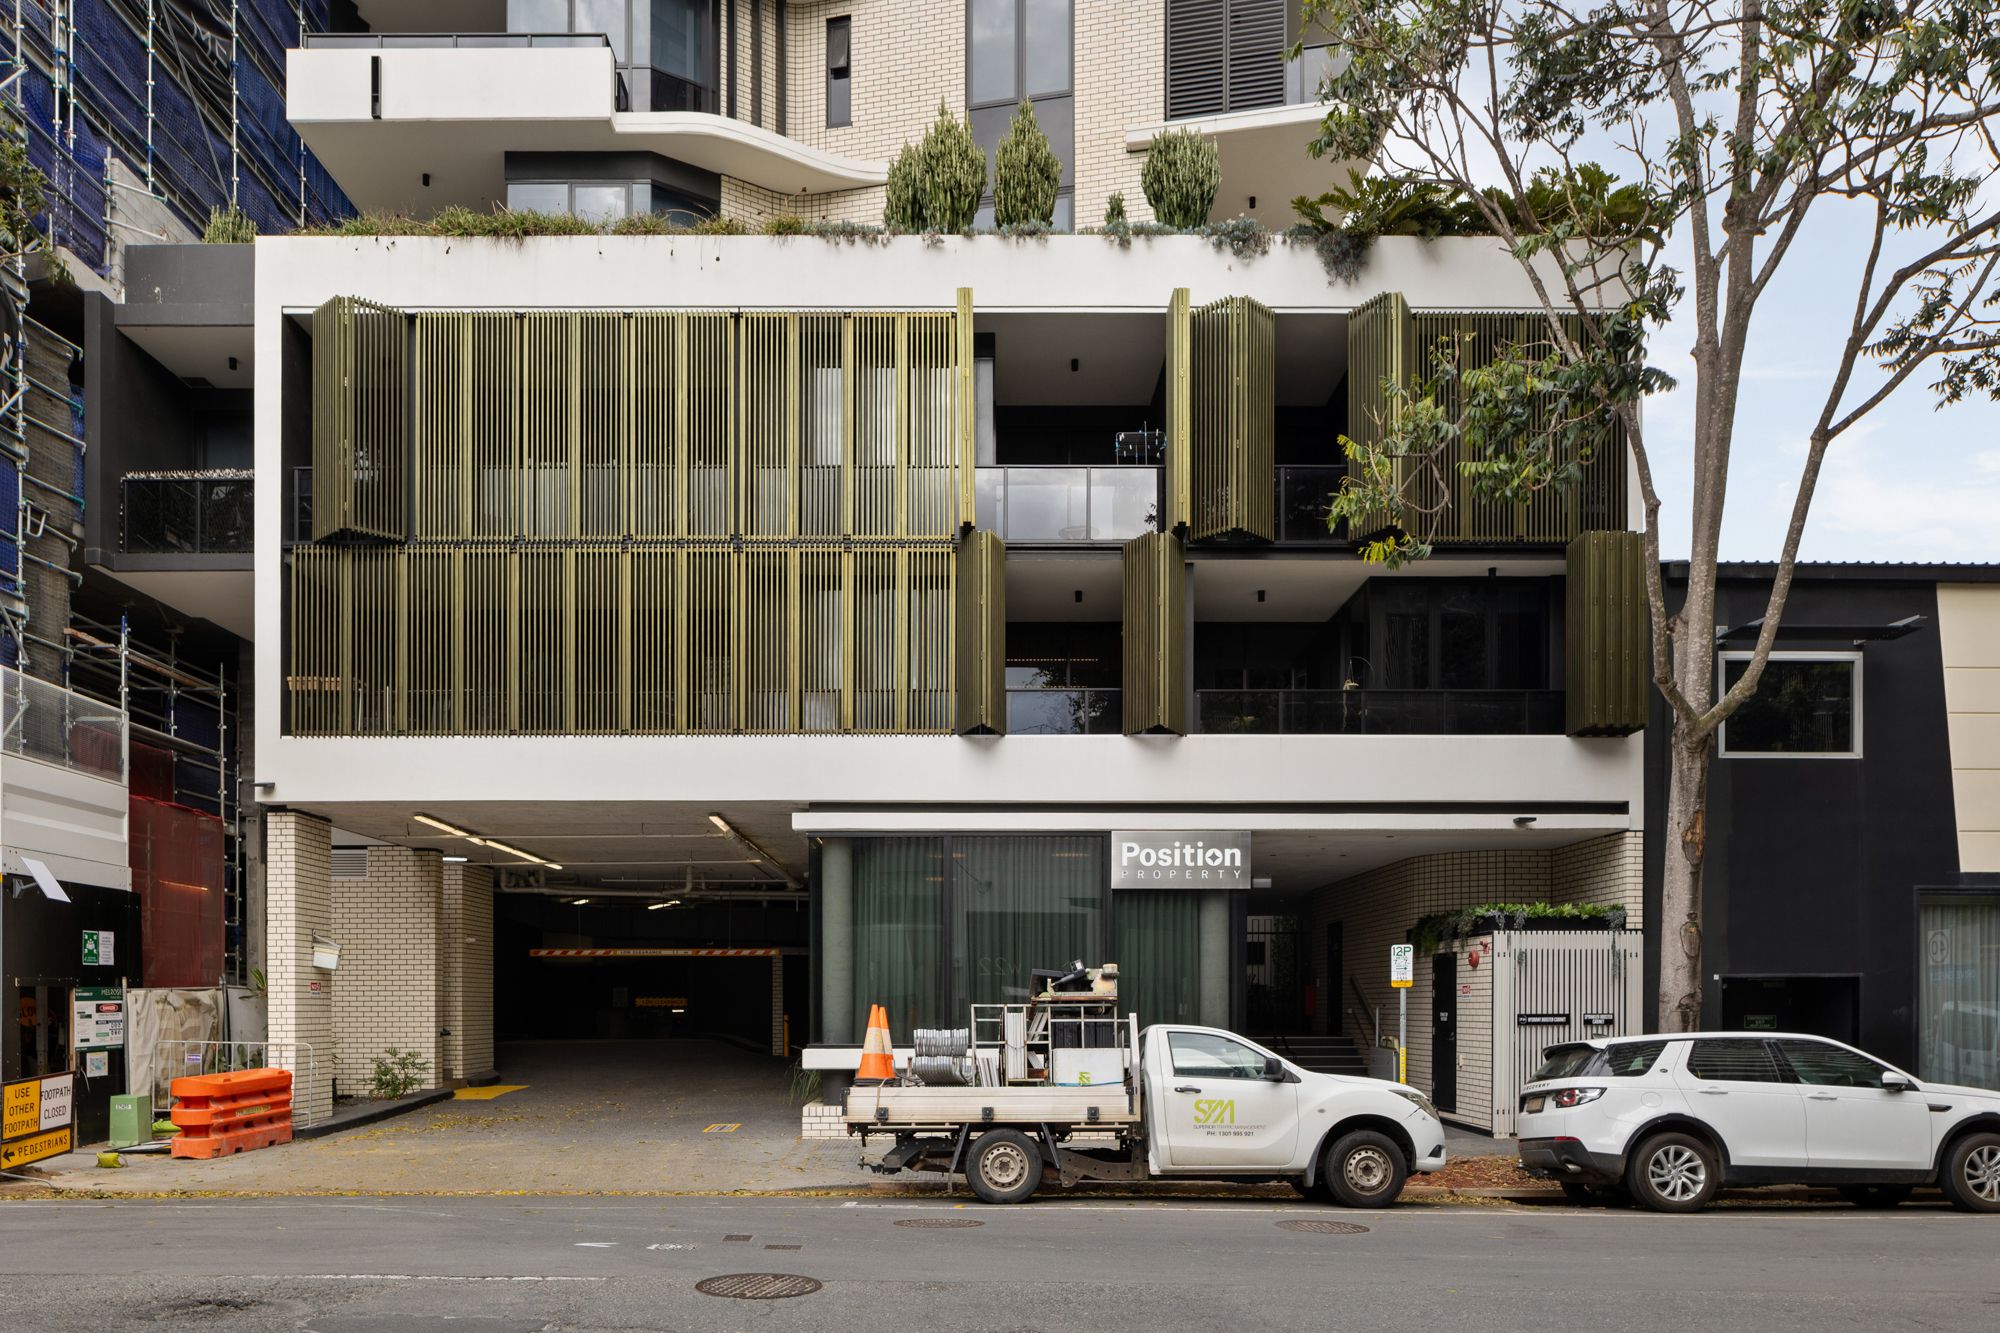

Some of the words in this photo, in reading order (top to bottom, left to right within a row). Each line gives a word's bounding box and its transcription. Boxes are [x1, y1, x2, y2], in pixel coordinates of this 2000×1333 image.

[1121, 841, 1241, 867] Position
[1121, 869, 1241, 879] PROPERTY
[1392, 946, 1412, 957] 12P
[14, 1087, 31, 1099] USE
[40, 1086, 71, 1101] FOOTPATH
[9, 1102, 35, 1116] OTHER
[44, 1105, 67, 1120] CLOSED
[4, 1117, 39, 1133] FOOTPATH
[17, 1134, 68, 1158] PEDESTRIANS
